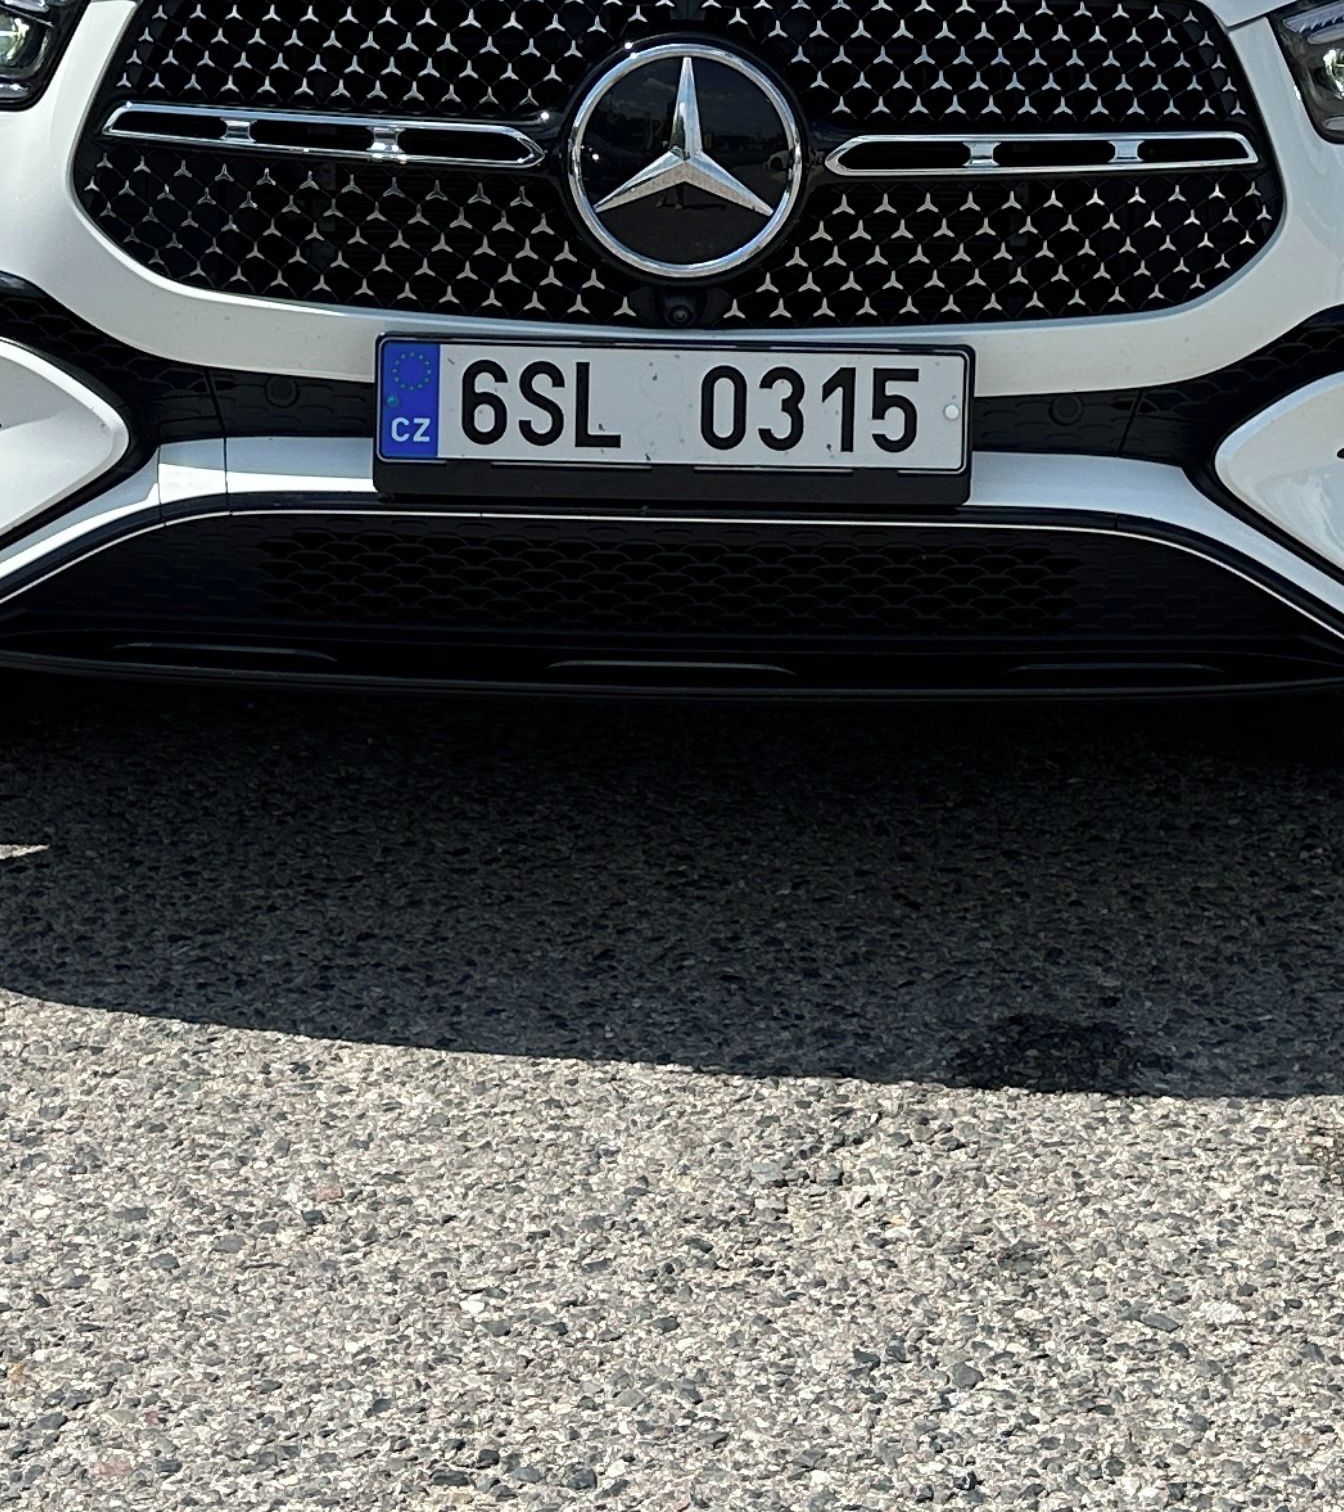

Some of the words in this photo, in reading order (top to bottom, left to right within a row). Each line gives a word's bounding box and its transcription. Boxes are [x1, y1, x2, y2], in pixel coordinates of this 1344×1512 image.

[391, 416, 431, 442] CZ
[460, 359, 622, 449] 6SL
[699, 364, 920, 454] 0315
